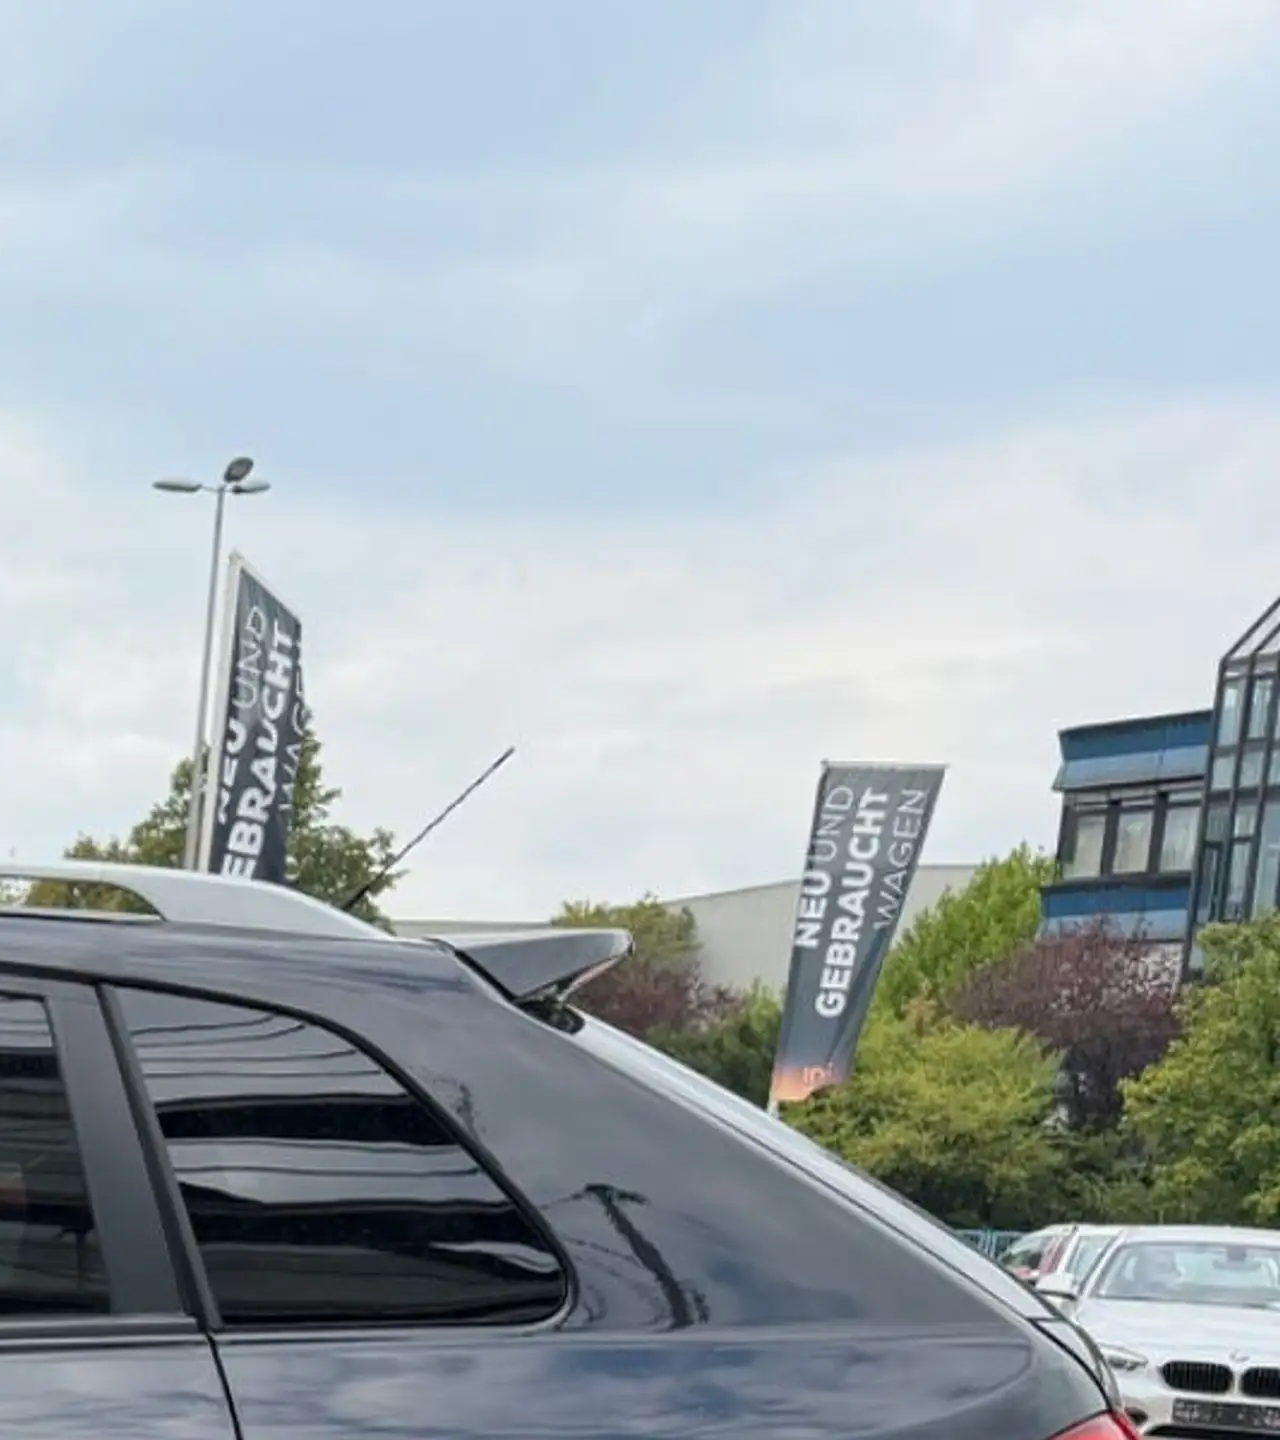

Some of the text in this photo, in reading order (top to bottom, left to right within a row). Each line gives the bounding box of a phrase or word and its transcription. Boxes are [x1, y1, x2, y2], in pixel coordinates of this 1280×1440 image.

[233, 606, 267, 708] UND
[794, 785, 854, 948] NEU UND
[815, 788, 889, 1017] GEBRAUCHT
[873, 787, 927, 930] WAGEN
